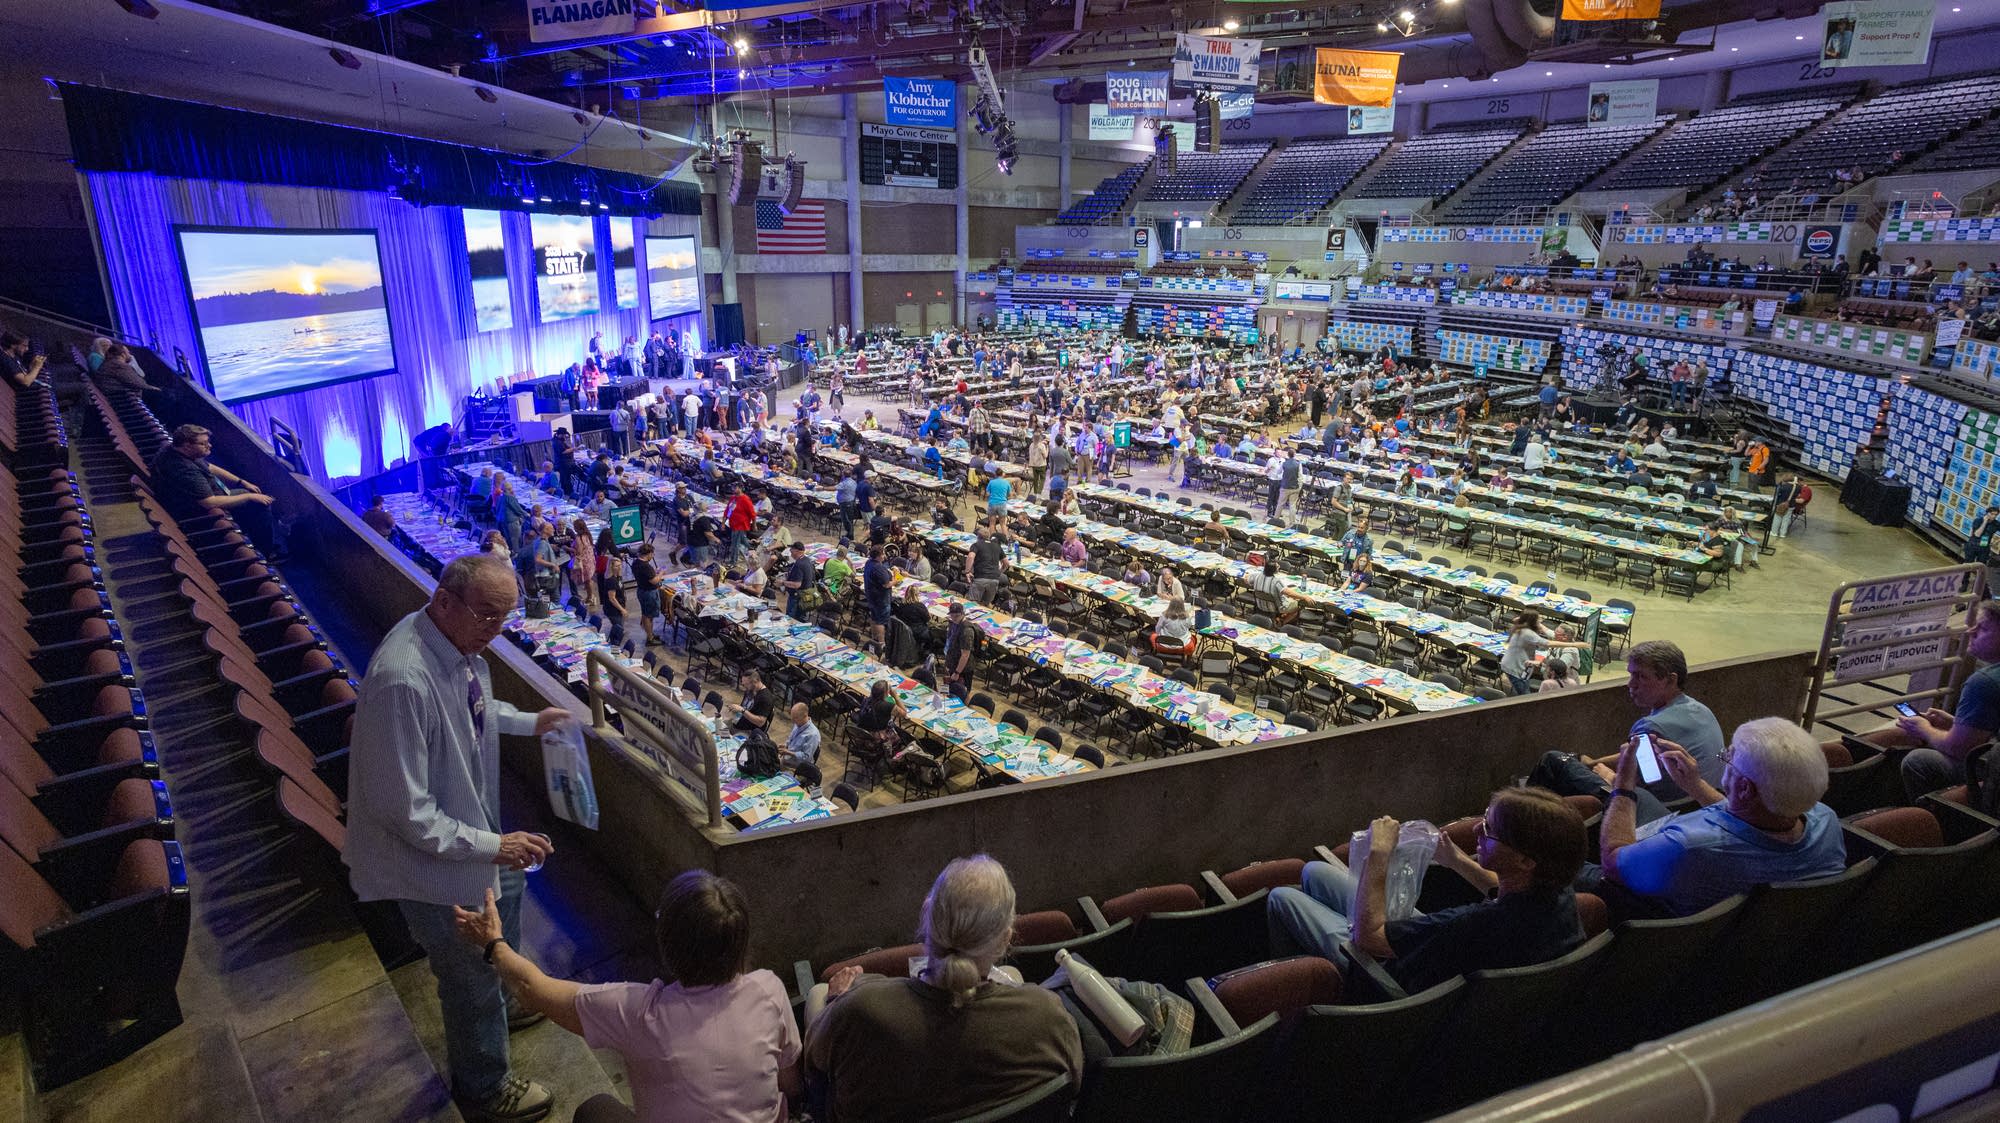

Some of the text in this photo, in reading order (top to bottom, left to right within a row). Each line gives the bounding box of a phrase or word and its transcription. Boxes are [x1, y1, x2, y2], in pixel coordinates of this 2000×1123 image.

[532, 0, 632, 25] FLANAGAN
[1858, 9, 1931, 19] SUPPORT FAMILY
[1858, 20, 1897, 28] FARMERS
[1860, 33, 1890, 41] Support
[1892, 33, 1911, 41] Prop
[1206, 39, 1232, 55] TRINA
[1193, 54, 1241, 73] SWANSON
[906, 80, 935, 96] Amy
[1108, 78, 1140, 88] DOUG
[889, 92, 951, 107] Klobuchar
[1108, 87, 1167, 102] CHAPIN
[893, 106, 947, 116] FOR GOVERNOR
[1487, 100, 1510, 114] 215
[1091, 117, 1134, 127] WOLGAMOTT
[1225, 118, 1251, 130] 205
[871, 125, 949, 141] Mayo Civic Center
[1066, 227, 1089, 238] 100
[1224, 228, 1242, 239] 105
[1331, 233, 1342, 245] G
[1449, 228, 1467, 241] 110
[1608, 227, 1626, 242] 115
[1770, 225, 1797, 243] 120
[546, 256, 580, 276] STATE
[1477, 367, 1484, 376] 3
[1119, 431, 1125, 444] 1
[620, 520, 635, 539] 6
[1853, 582, 1902, 605] ZACK
[1904, 574, 1959, 597] ZACK
[1839, 643, 1939, 670] FILIPOVICH FILIPOVICH
